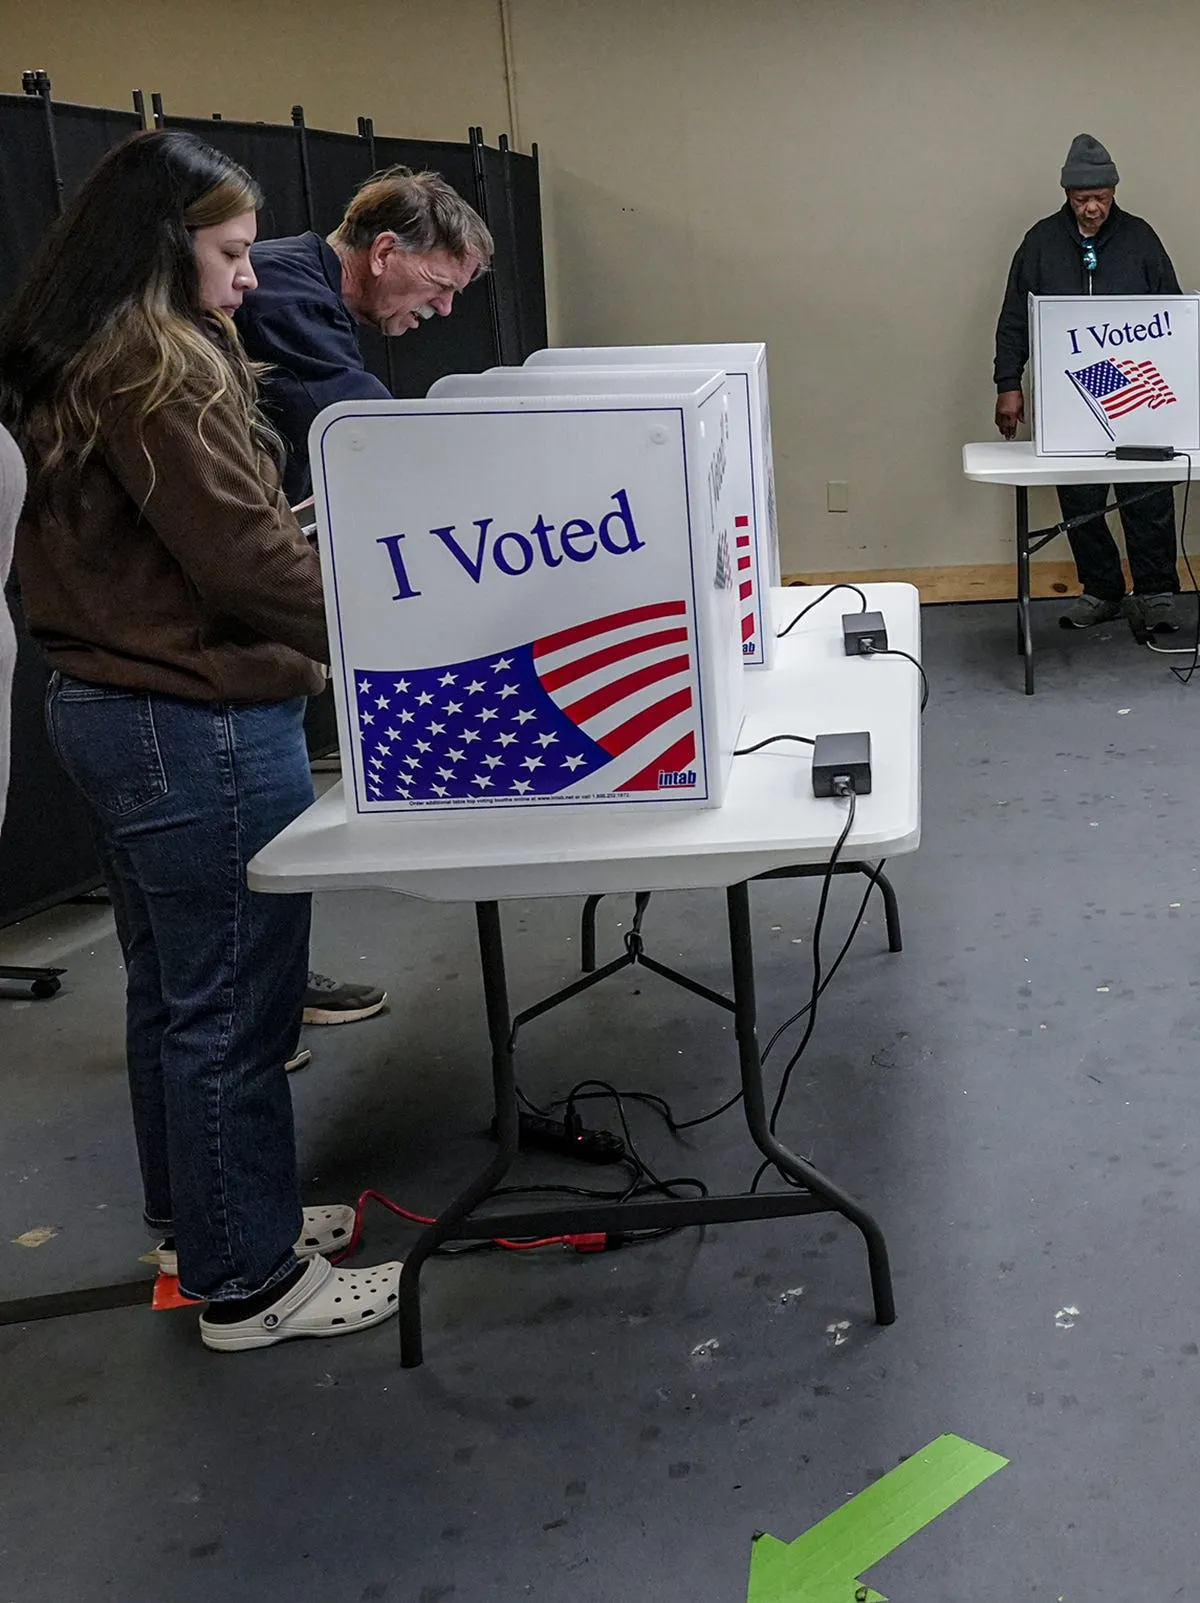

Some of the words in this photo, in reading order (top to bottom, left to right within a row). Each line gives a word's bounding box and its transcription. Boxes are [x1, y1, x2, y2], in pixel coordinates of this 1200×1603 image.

[1067, 328, 1083, 355] I
[1086, 311, 1173, 349] Voted!
[376, 534, 421, 600] I
[429, 489, 645, 583] Voted
[659, 769, 697, 785] intab
